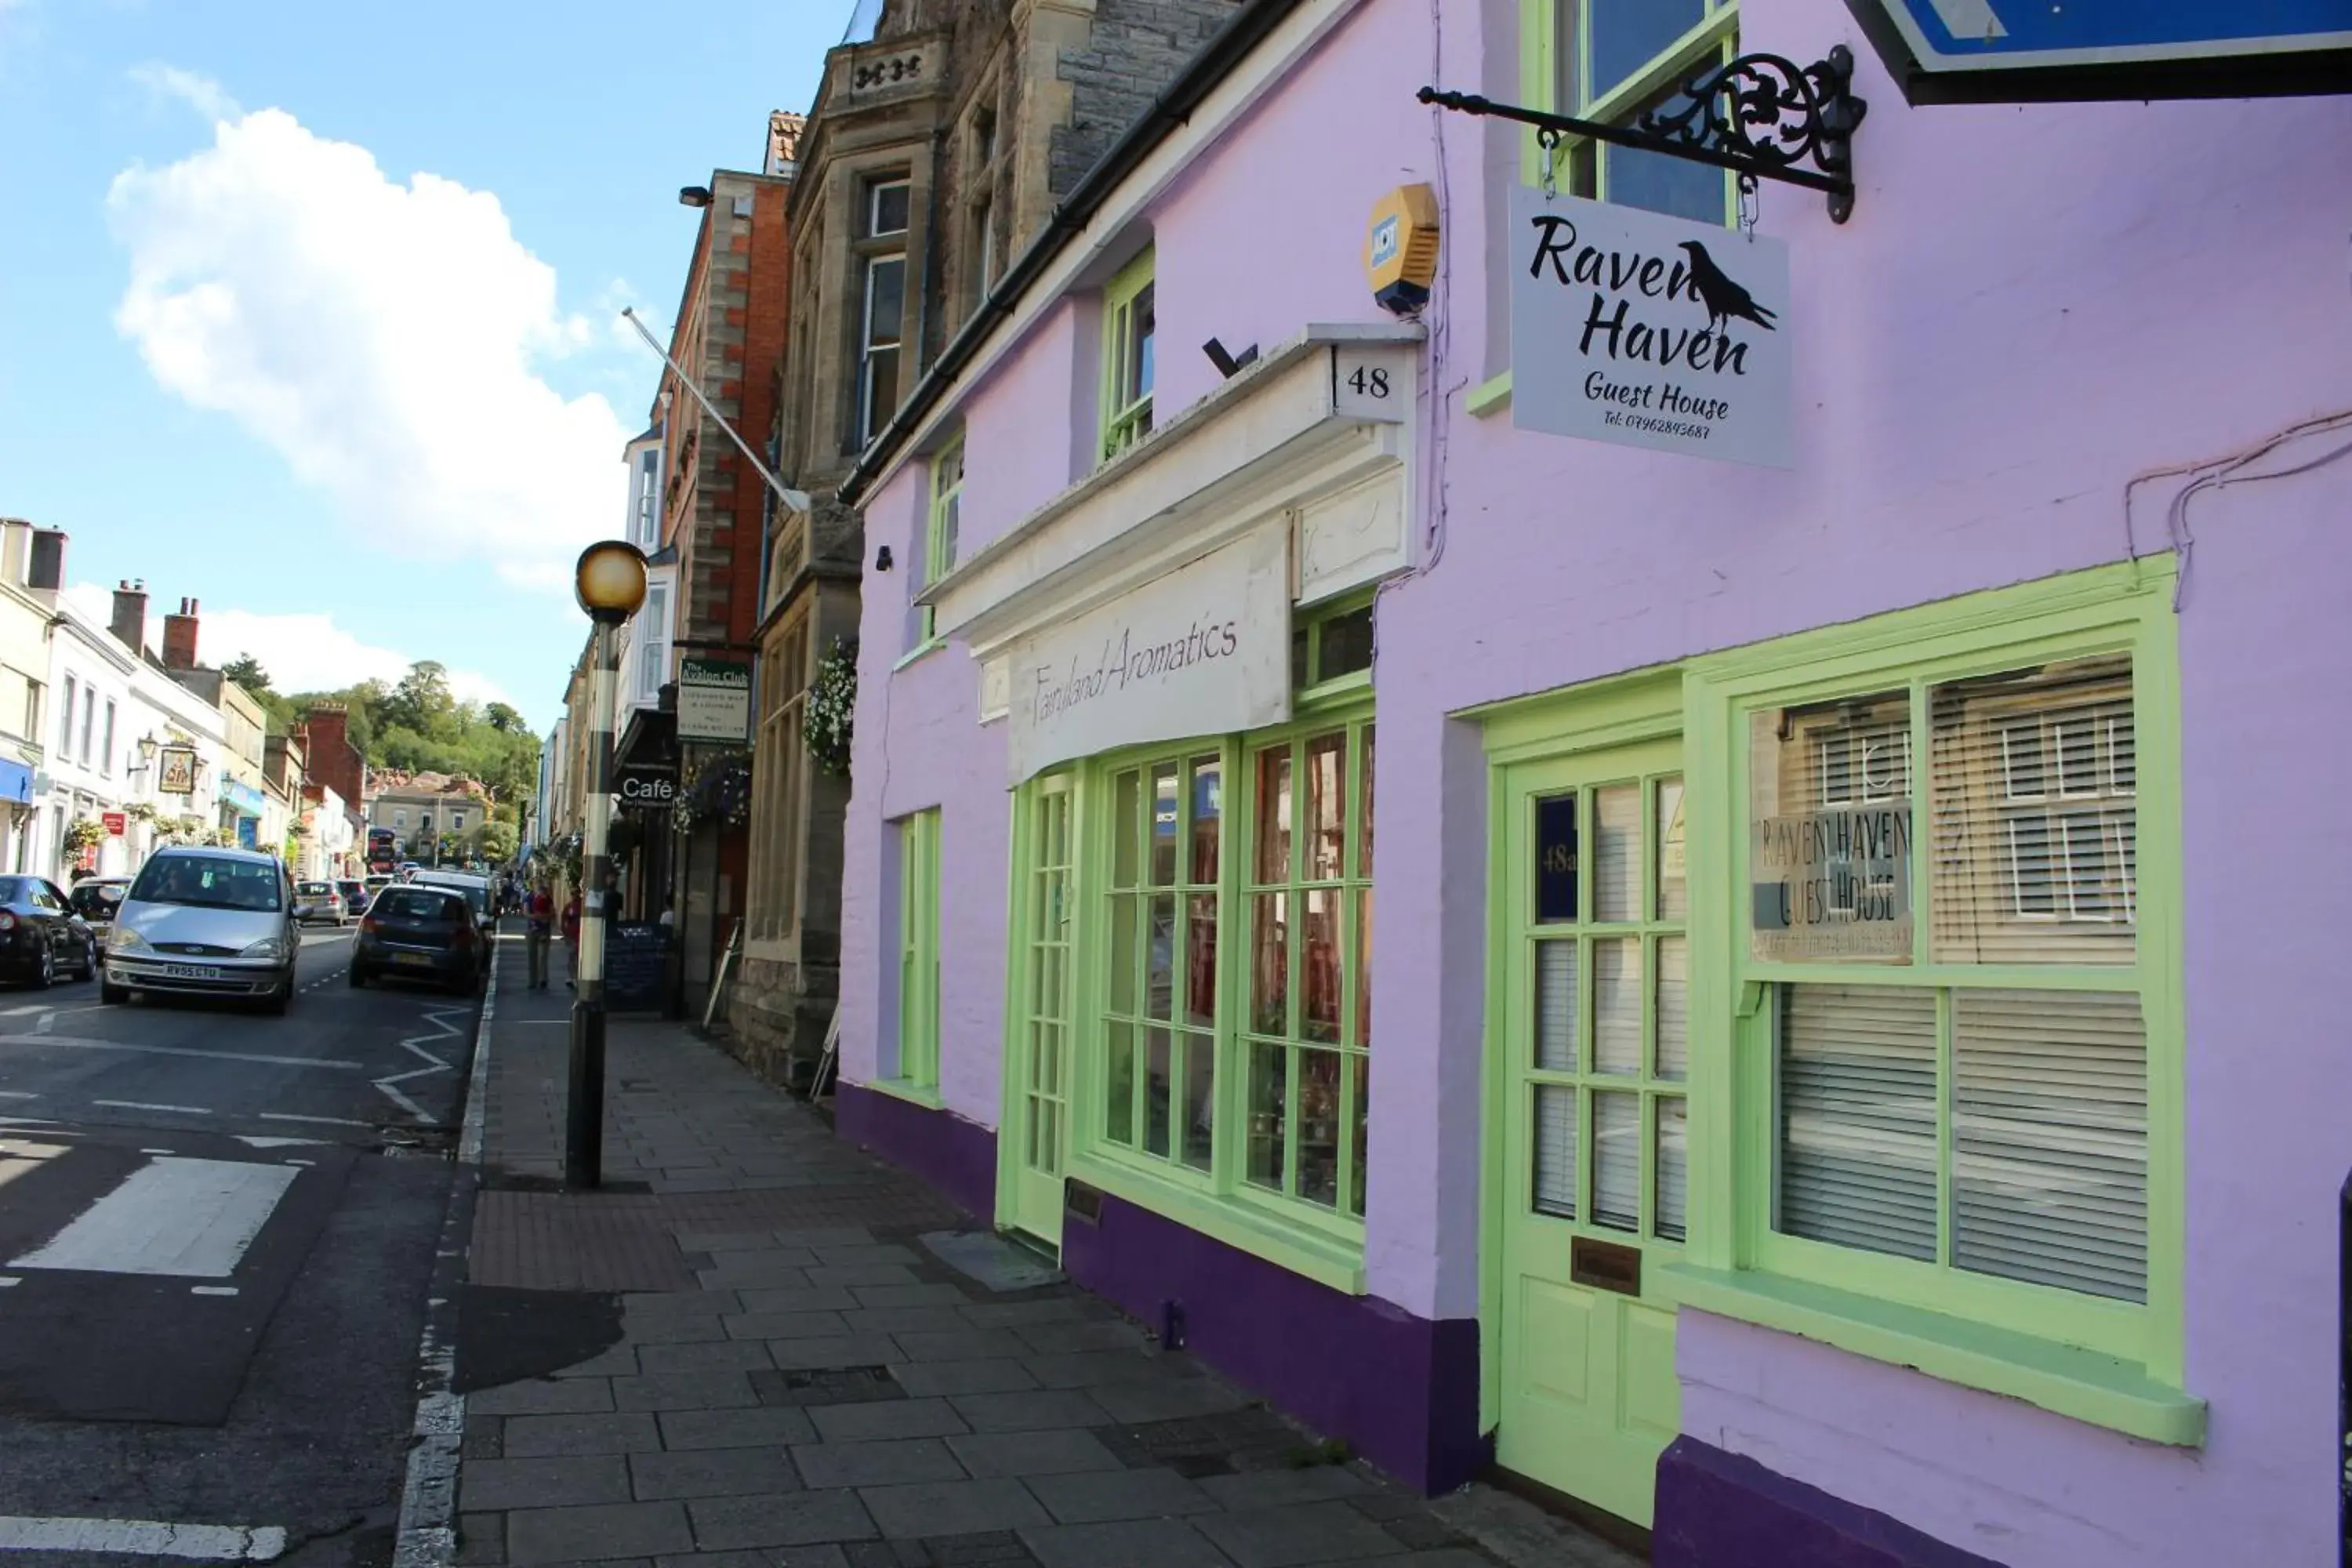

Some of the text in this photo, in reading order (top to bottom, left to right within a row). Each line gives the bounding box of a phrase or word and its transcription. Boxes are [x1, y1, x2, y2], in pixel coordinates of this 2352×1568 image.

[1530, 216, 1701, 302] Raven
[1580, 292, 1748, 375] Haven
[1348, 365, 1390, 399] 48
[1584, 370, 1729, 420] Guest House
[1605, 410, 1622, 426] Tel:
[1033, 611, 1237, 728] Fairyland Aromatics
[623, 777, 673, 799] Café
[1543, 843, 1577, 873] 48a
[1762, 810, 1912, 866] RAVEN HAVEN
[1780, 871, 1895, 927] GUEST HOUSE
